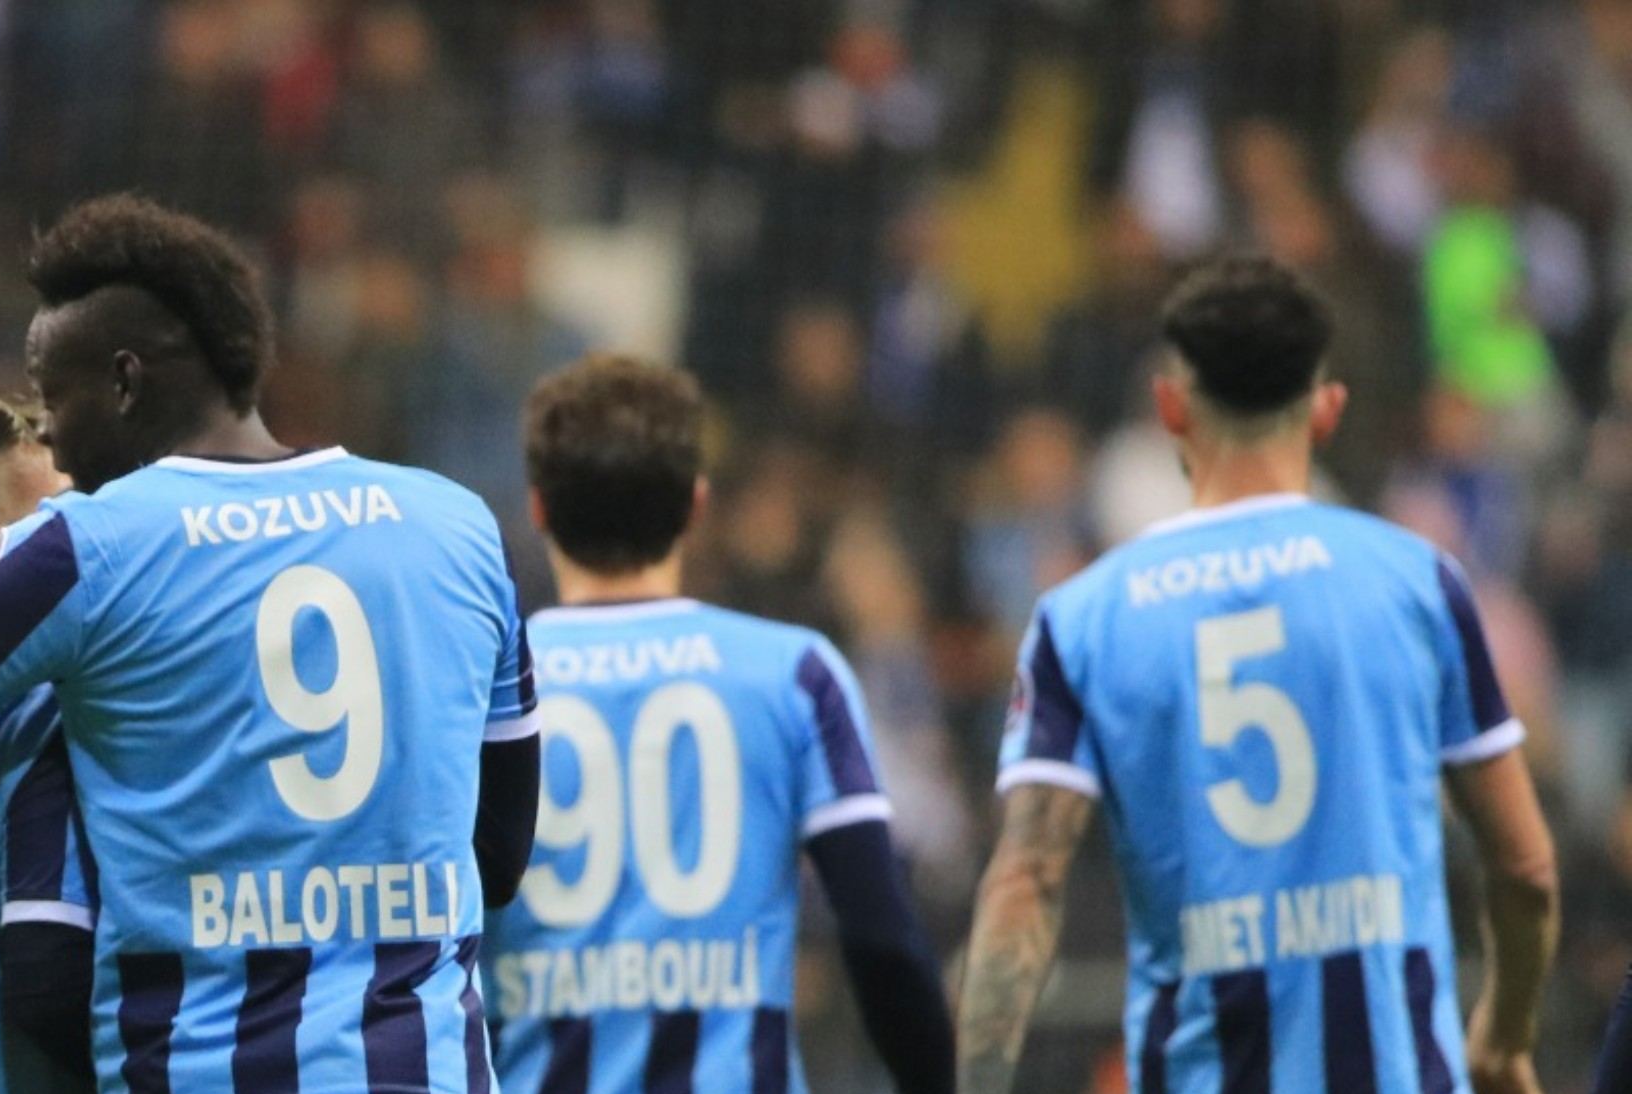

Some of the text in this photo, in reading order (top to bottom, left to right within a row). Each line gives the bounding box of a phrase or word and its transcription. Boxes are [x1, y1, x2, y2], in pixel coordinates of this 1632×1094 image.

[180, 484, 402, 547] KOZUVA
[1125, 536, 1332, 607] KOZUVA
[256, 564, 384, 822] 9
[536, 634, 723, 686] OZUVA
[1194, 605, 1317, 849] 5
[520, 680, 744, 930] 90
